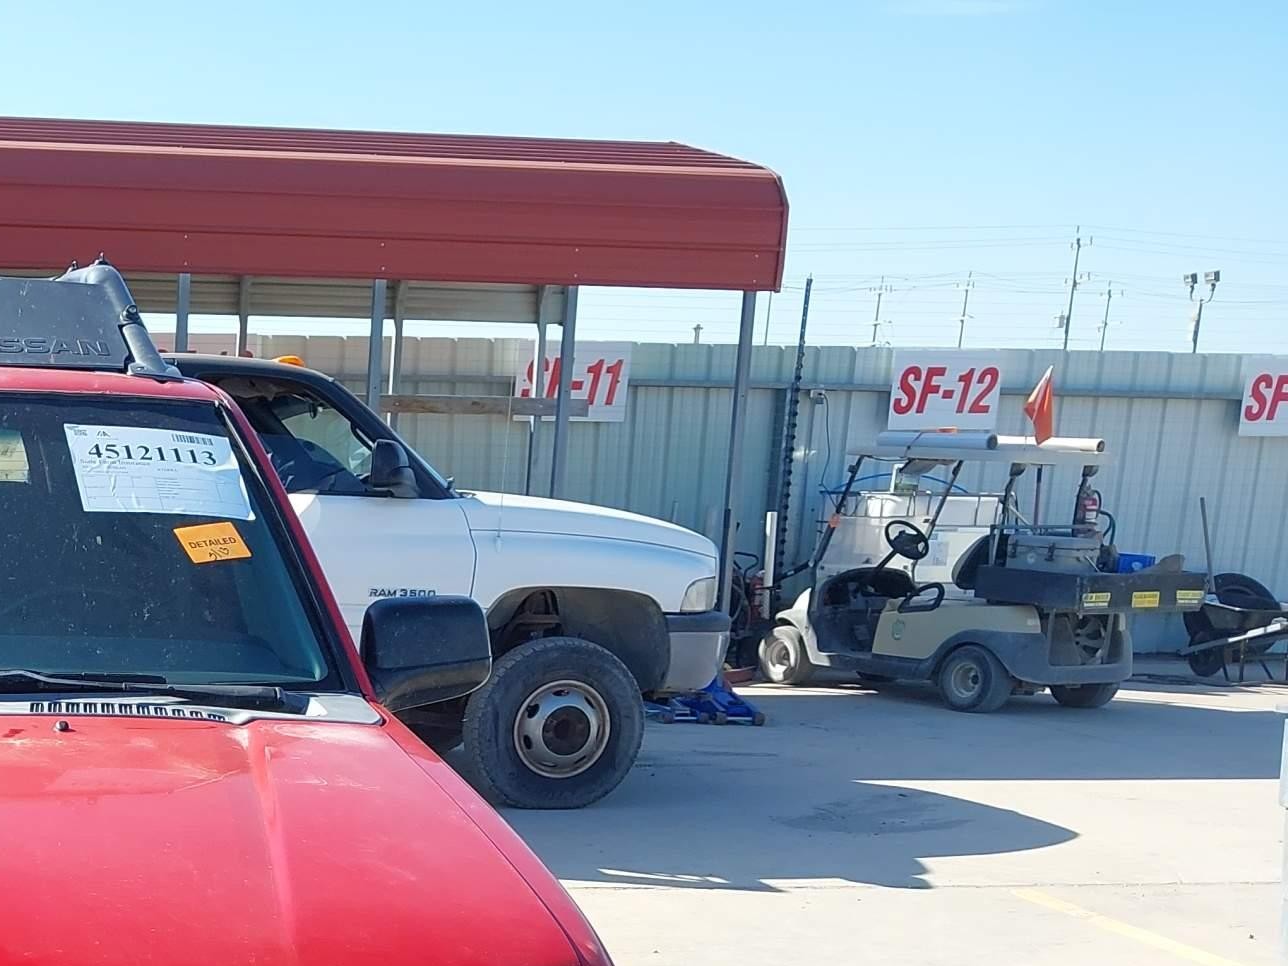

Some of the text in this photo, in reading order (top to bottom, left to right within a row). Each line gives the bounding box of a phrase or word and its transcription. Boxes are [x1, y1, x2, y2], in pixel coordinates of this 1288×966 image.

[893, 365, 999, 414] SF-12
[88, 443, 216, 466] 45121113
[188, 536, 237, 549] DETAILED
[368, 588, 437, 598] RAM 3500
